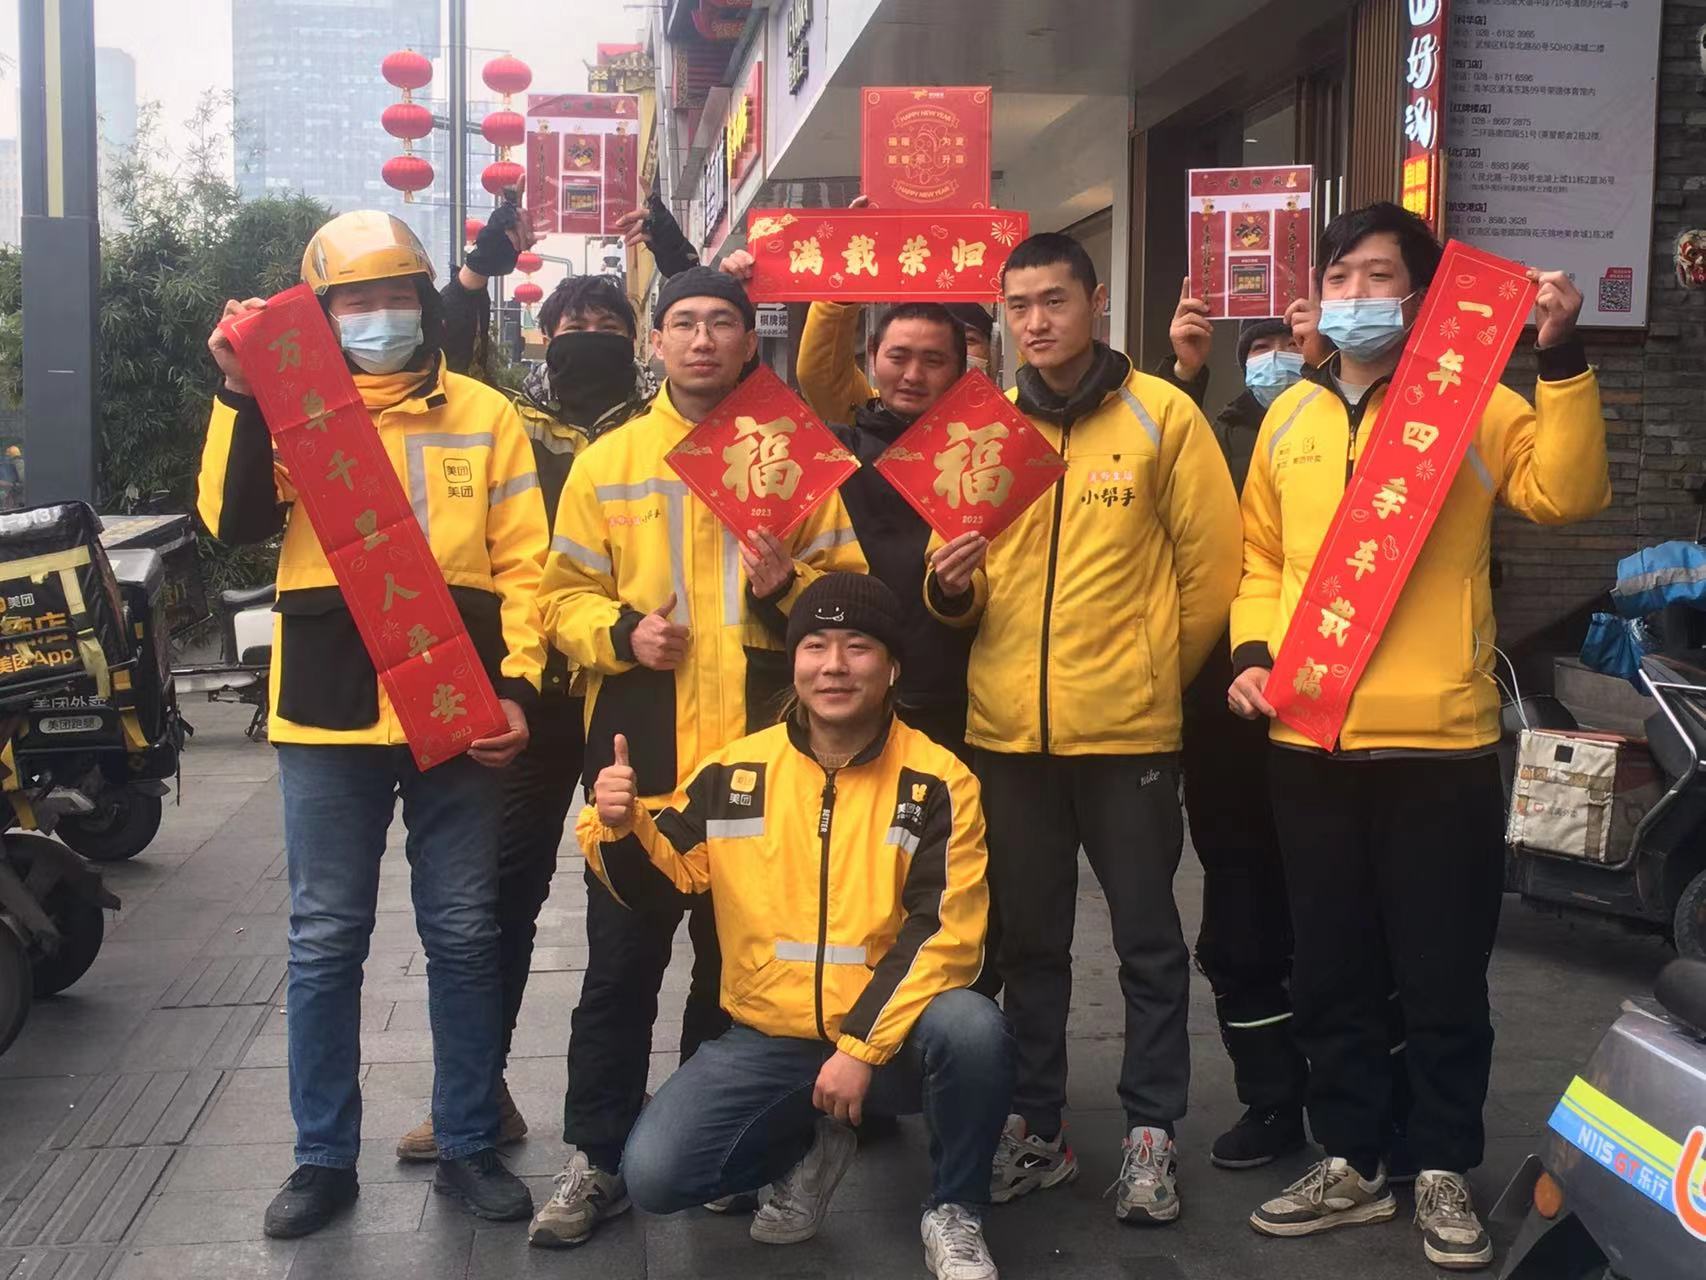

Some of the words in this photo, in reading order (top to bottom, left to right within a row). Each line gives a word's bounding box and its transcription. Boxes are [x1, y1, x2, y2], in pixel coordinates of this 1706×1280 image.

[900, 110, 920, 122] HAPPY
[920, 109, 935, 117] NEW
[935, 111, 952, 122] YEAR
[789, 234, 987, 277] 满载荣归
[722, 415, 804, 502] 福
[932, 421, 1015, 510] 福
[446, 465, 469, 477] 美团
[448, 485, 474, 498] 美团
[1081, 486, 1136, 508] 小帮手
[1292, 299, 1493, 702] 一年四季车载福
[751, 507, 771, 518] 2023
[962, 513, 984, 525] 2023
[268, 329, 469, 724] 万单千里人平安
[7, 593, 36, 609] 美团
[729, 792, 752, 806] 美团
[820, 808, 831, 833] BETTER
